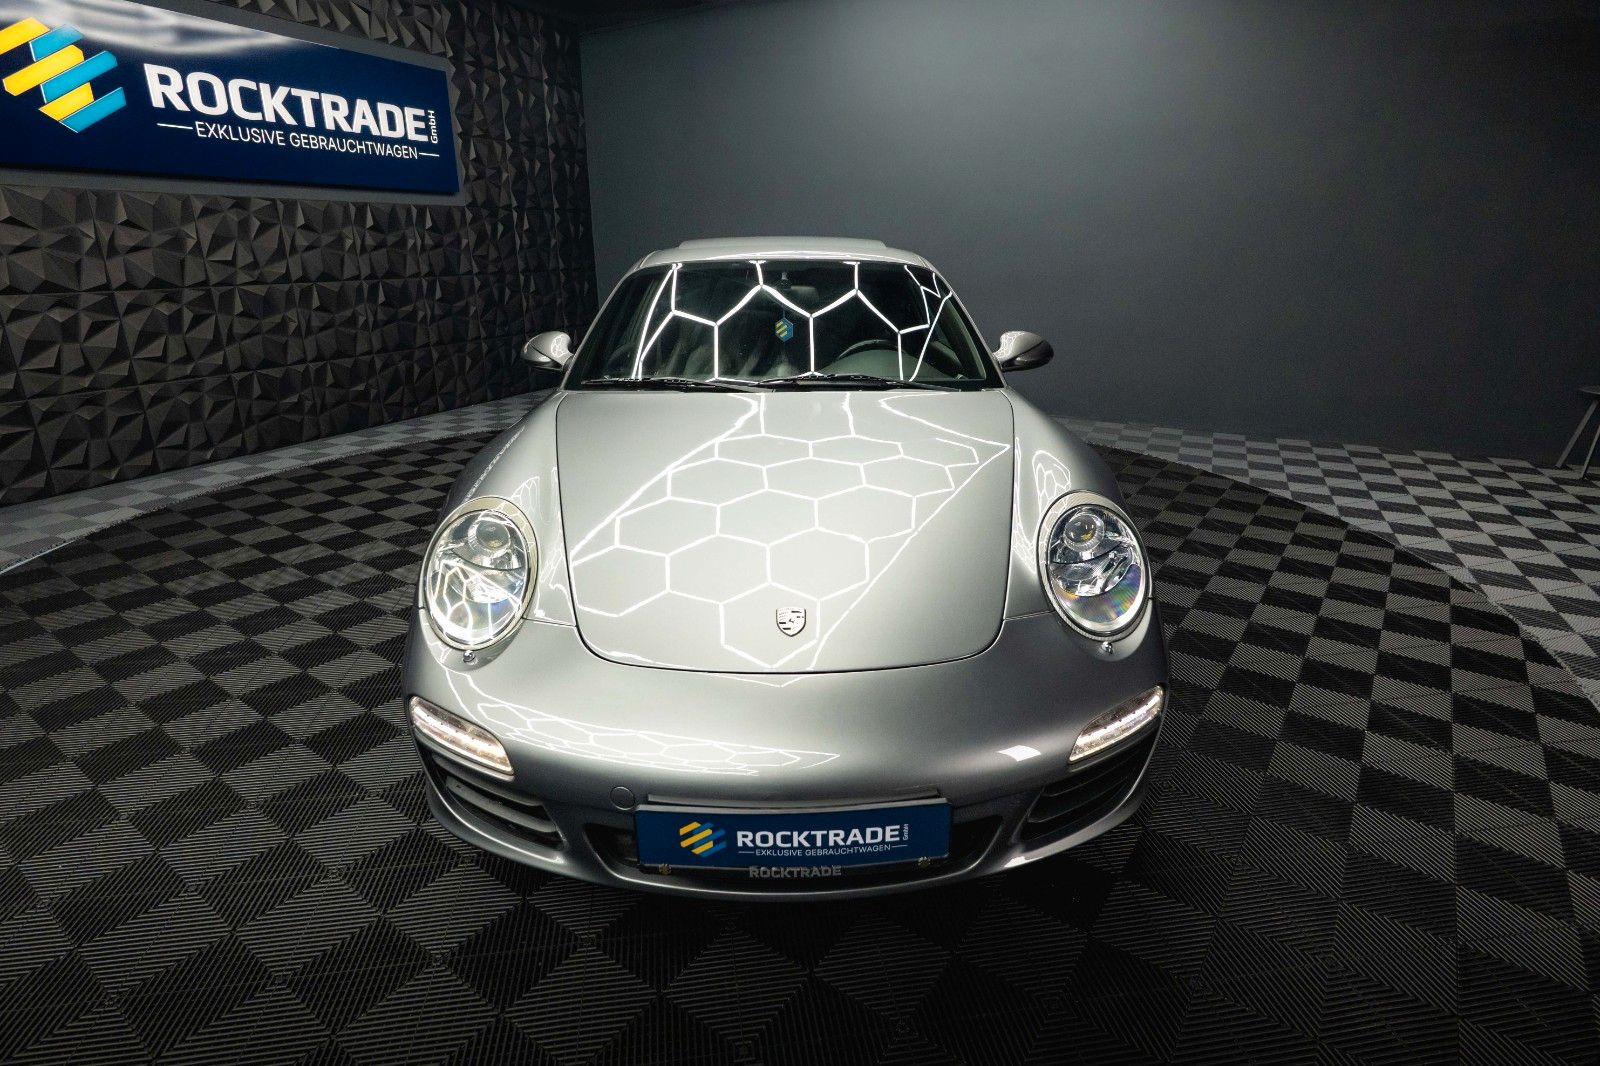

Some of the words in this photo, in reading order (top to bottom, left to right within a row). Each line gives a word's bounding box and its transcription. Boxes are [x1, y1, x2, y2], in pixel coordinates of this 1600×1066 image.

[143, 63, 429, 142] ROCKTRADE
[195, 121, 286, 147] EXKLUSIVE
[289, 132, 419, 160] GEBRAUCHTWAGEN
[427, 109, 439, 144] GmbH
[736, 825, 900, 848] ROCKTRADE
[755, 848, 803, 857] EXKLUSIVE
[805, 843, 892, 857] GEBRAUCHTWAGEN
[750, 865, 842, 879] ROCKTRADE
